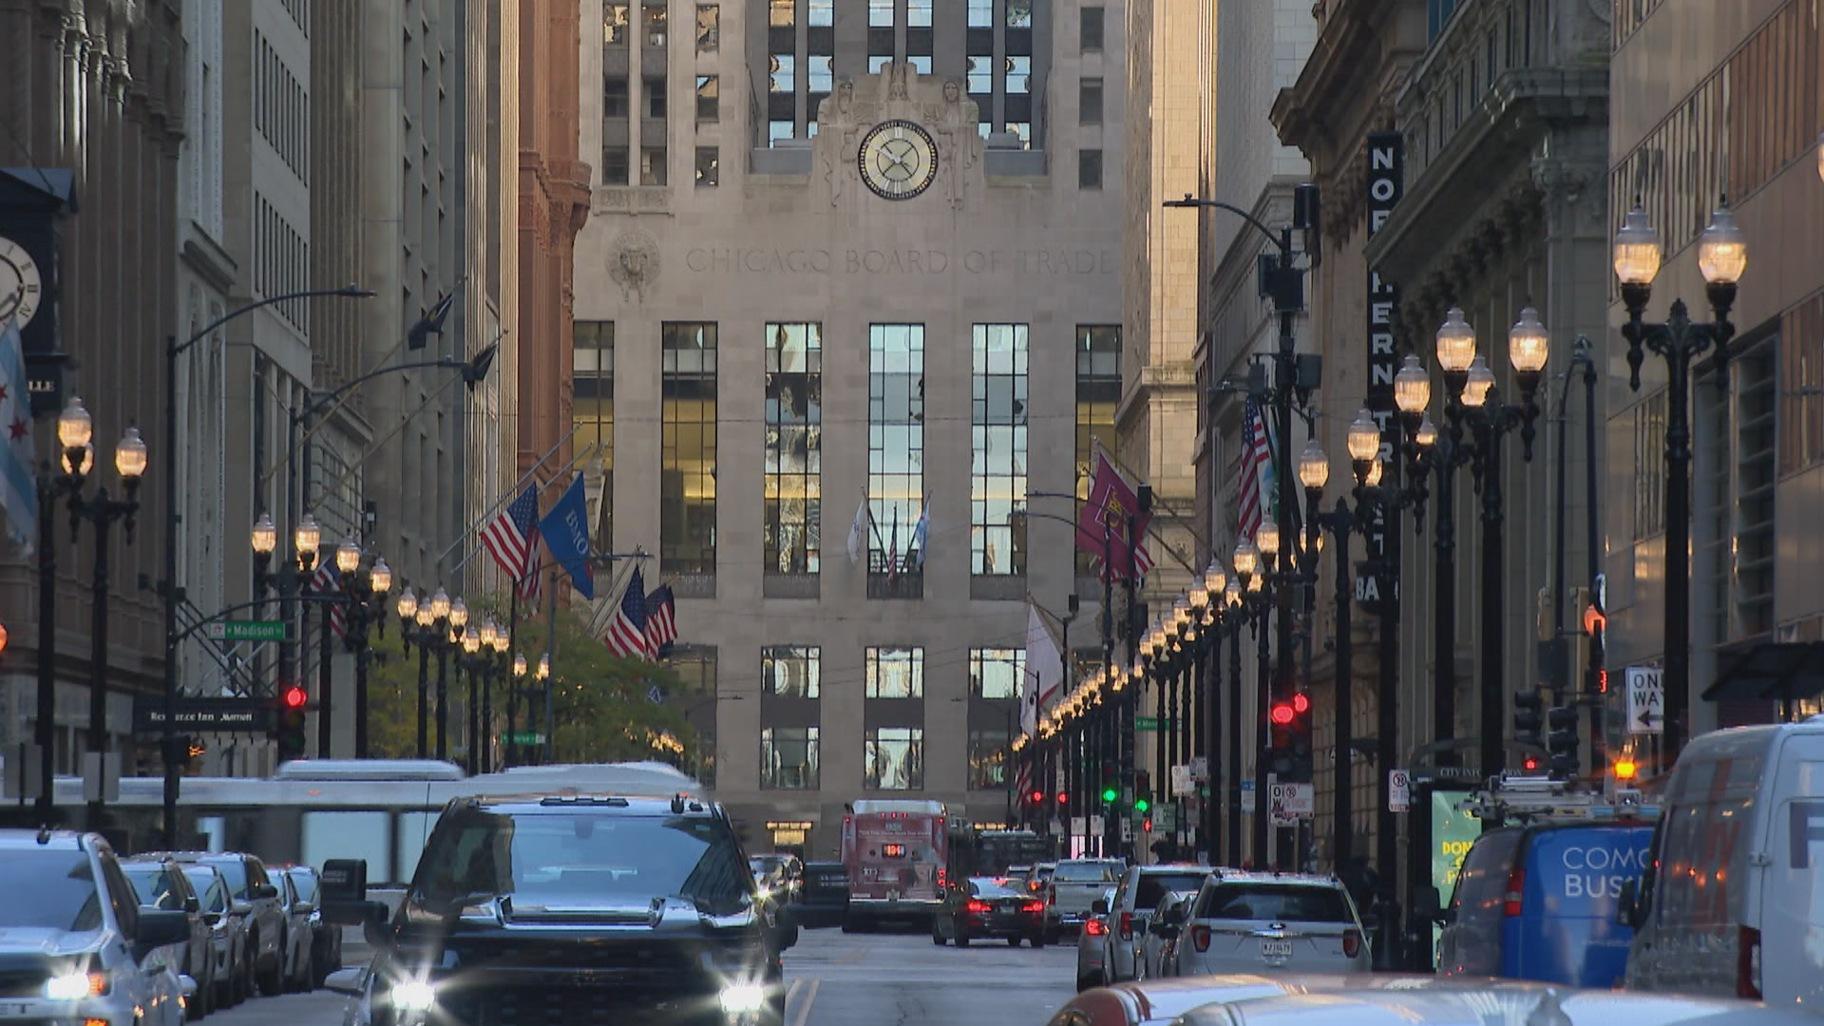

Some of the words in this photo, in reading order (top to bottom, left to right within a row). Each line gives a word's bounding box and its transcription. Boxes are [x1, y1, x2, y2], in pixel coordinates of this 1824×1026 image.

[686, 249, 831, 272] CHICAGO
[846, 249, 948, 274] BOARD
[963, 250, 1004, 274] OF
[1016, 249, 1114, 274] TRADE
[1371, 147, 1395, 386] NORHERN
[566, 510, 588, 556] BMO
[233, 625, 275, 637] Madison
[1633, 673, 1664, 688] ON
[1633, 691, 1664, 707] WA
